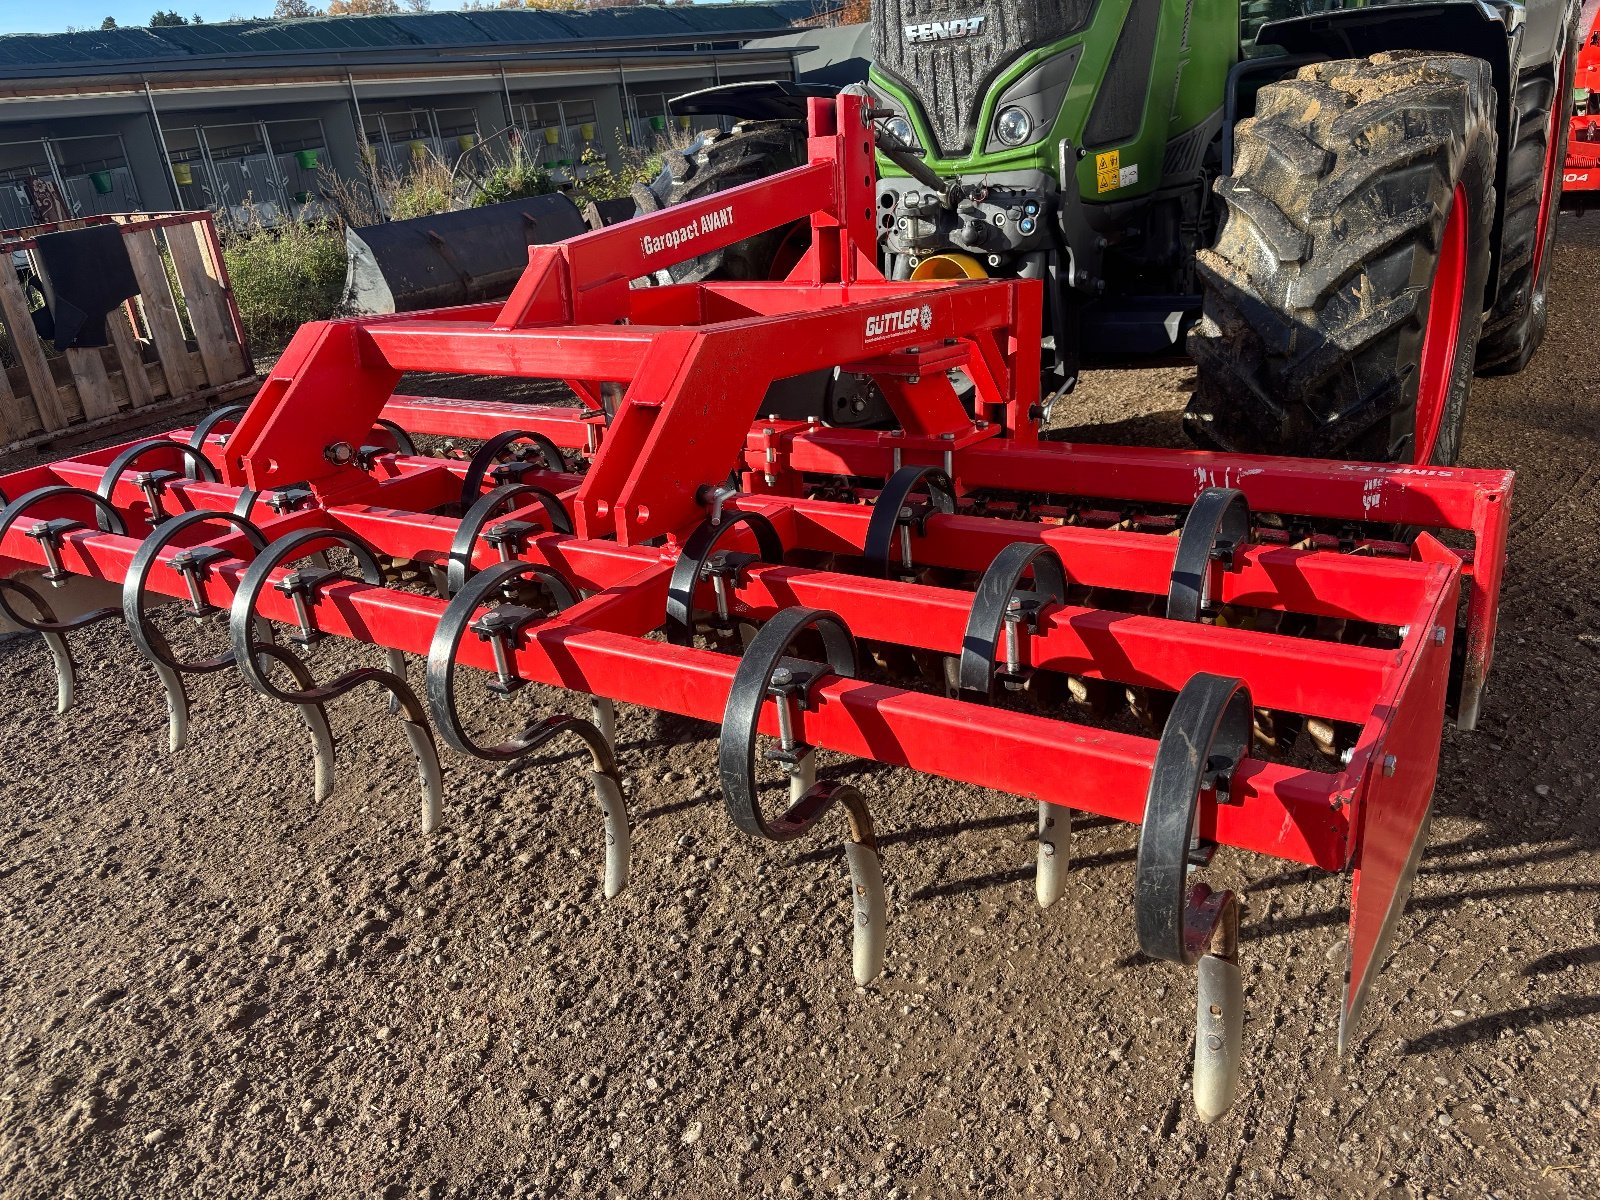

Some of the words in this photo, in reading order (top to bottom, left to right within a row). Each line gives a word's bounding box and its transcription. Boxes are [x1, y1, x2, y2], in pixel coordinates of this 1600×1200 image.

[904, 16, 985, 43] FENDT
[643, 219, 699, 255] Garopact
[700, 205, 734, 235] AVANT
[865, 307, 920, 337] GÜTTLER
